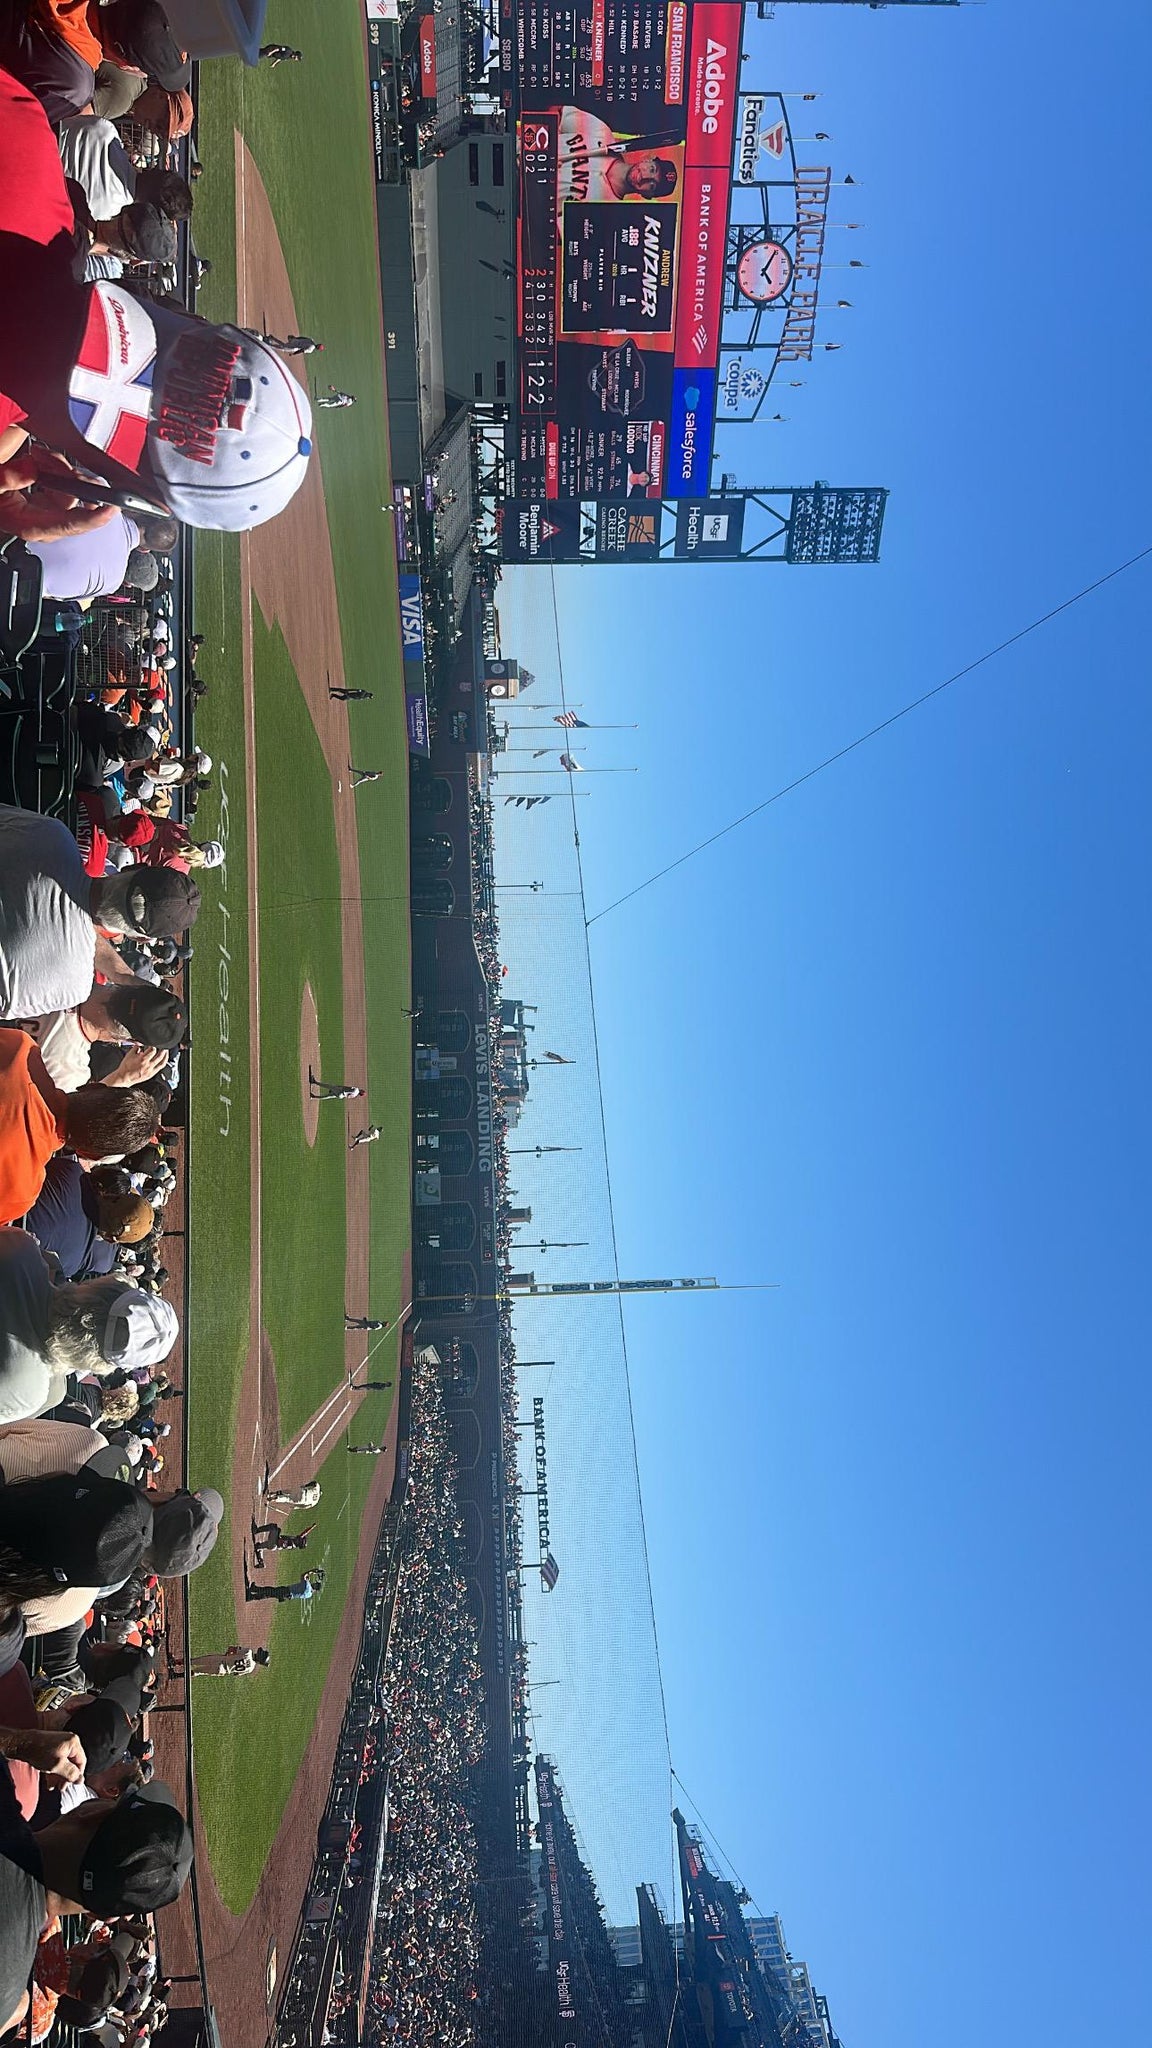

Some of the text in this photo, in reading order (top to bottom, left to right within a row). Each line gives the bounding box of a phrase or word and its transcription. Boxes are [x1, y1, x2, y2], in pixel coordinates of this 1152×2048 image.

[370, 24, 379, 44] 399
[423, 39, 432, 73] Adobe
[502, 39, 511, 71] $8,890
[669, 7, 684, 100] SAN FRANCISCO
[696, 57, 704, 78] Made
[696, 80, 702, 88] to
[702, 38, 727, 134] Adobe
[372, 92, 380, 121] KONICA
[374, 122, 382, 155] MINOLTA
[740, 99, 763, 181] Fanatics
[628, 226, 639, 246] .188
[693, 184, 711, 322] BANK OF AMERICA
[620, 265, 627, 275] HR
[641, 215, 661, 318] KNIZNER
[661, 249, 670, 286] ANDREW
[777, 166, 832, 363] ORACLE PARK
[108, 296, 131, 365] Dominican
[387, 332, 396, 349] 391
[528, 375, 545, 387] 2
[528, 393, 545, 404] 2
[723, 362, 741, 408] coupa
[626, 425, 635, 454] LODOLO
[680, 412, 697, 479] salesforce
[549, 457, 556, 466] UP
[651, 435, 662, 486] CINCINNATI
[519, 512, 528, 548] Moore
[528, 505, 540, 555] Benjamin
[607, 508, 616, 550] CREEK
[616, 507, 626, 552] CACHE
[686, 506, 700, 550] Health
[710, 517, 721, 539] UCSF
[401, 593, 421, 645] VISA
[415, 698, 424, 745] HealthEquity
[218, 902, 232, 1136] Health
[476, 1081, 491, 1172] LANDING
[534, 1398, 550, 1549] BANK OF AMERICA
[234, 1659, 245, 1672] 50
[553, 1929, 564, 1941] day
[557, 1977, 572, 2005] Health
[725, 1992, 737, 2012] TOYOTA
